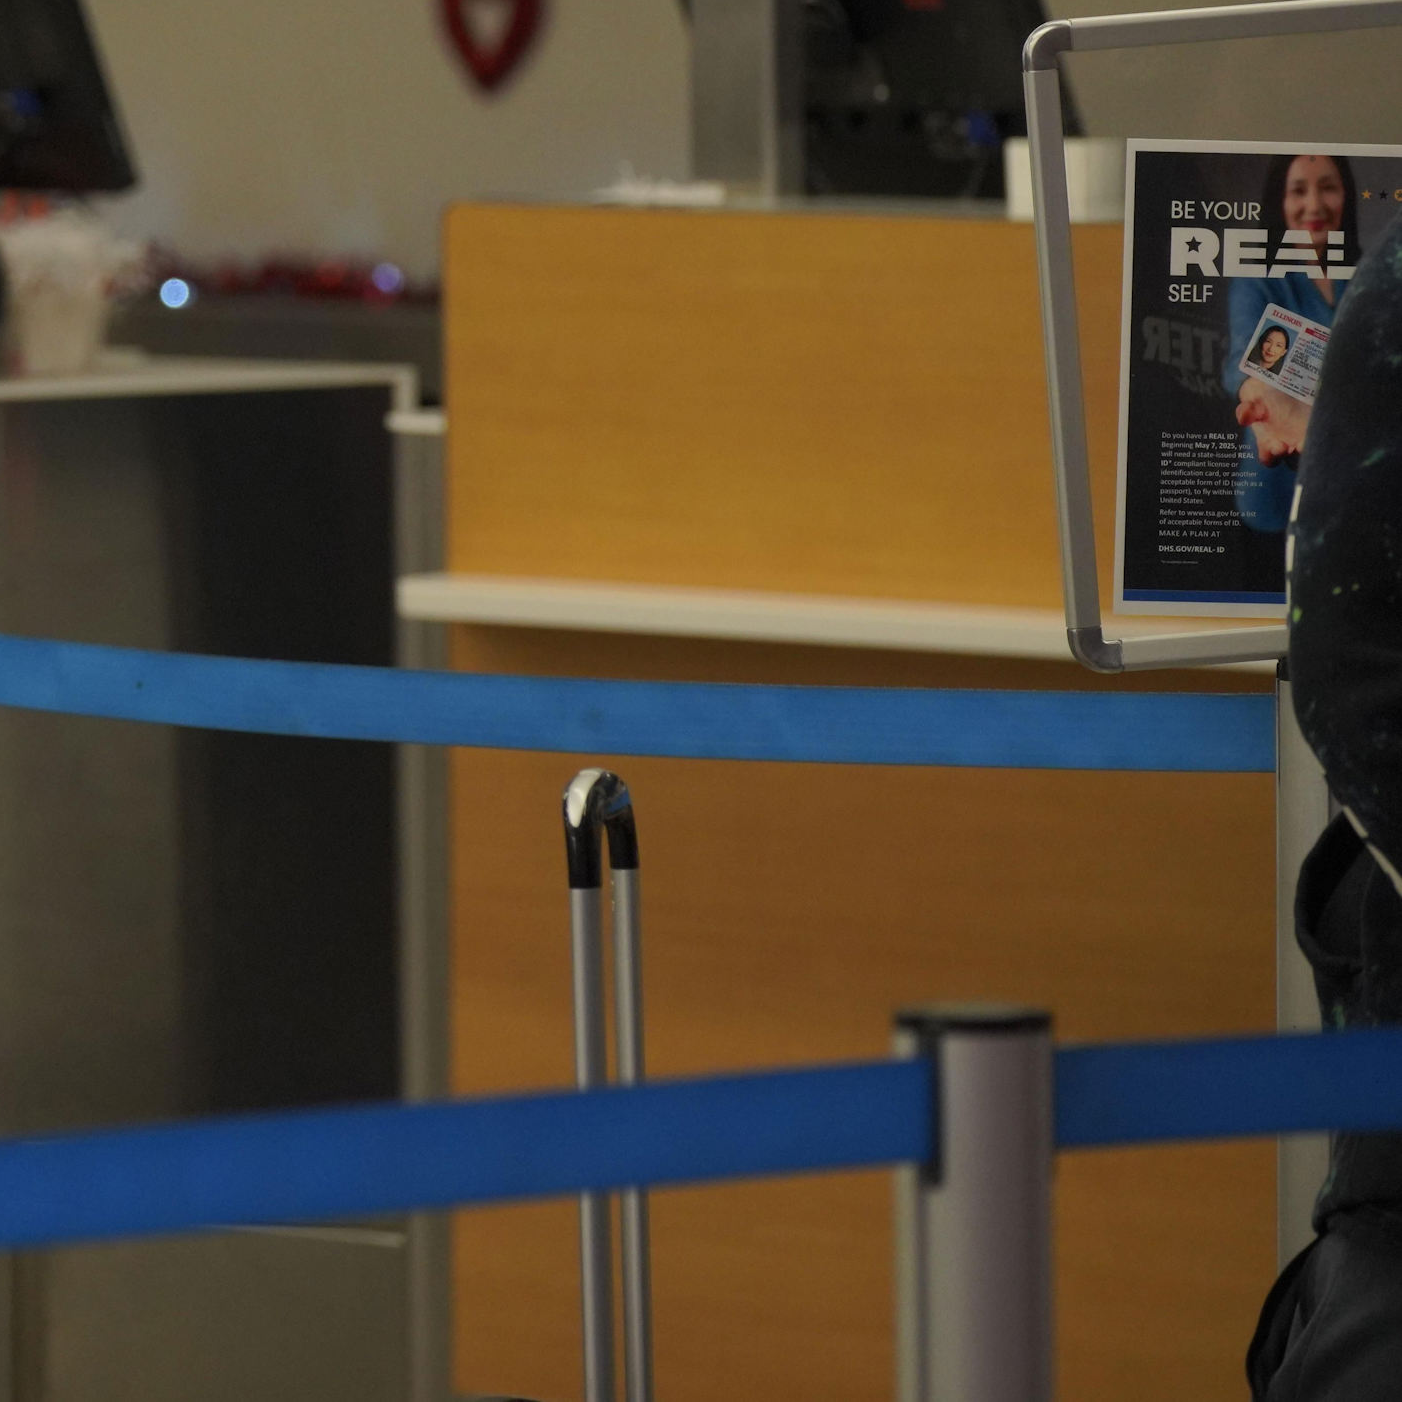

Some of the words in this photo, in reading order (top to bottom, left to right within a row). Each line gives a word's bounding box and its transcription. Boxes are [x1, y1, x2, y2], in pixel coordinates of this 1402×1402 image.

[1171, 200, 1195, 220] BE
[1201, 201, 1261, 221] YOUR
[1169, 226, 1357, 279] REAL
[1168, 284, 1213, 303] SELF
[1272, 309, 1303, 328] ILLINOIS
[1161, 441, 1194, 449] Beginning
[1194, 442, 1210, 450] May
[1173, 460, 1206, 468] compliant
[1160, 469, 1204, 477] identification
[1160, 479, 1195, 487] acceptable
[1231, 479, 1248, 487] (such
[1202, 488, 1211, 496] fly
[1167, 519, 1202, 527] acceptable
